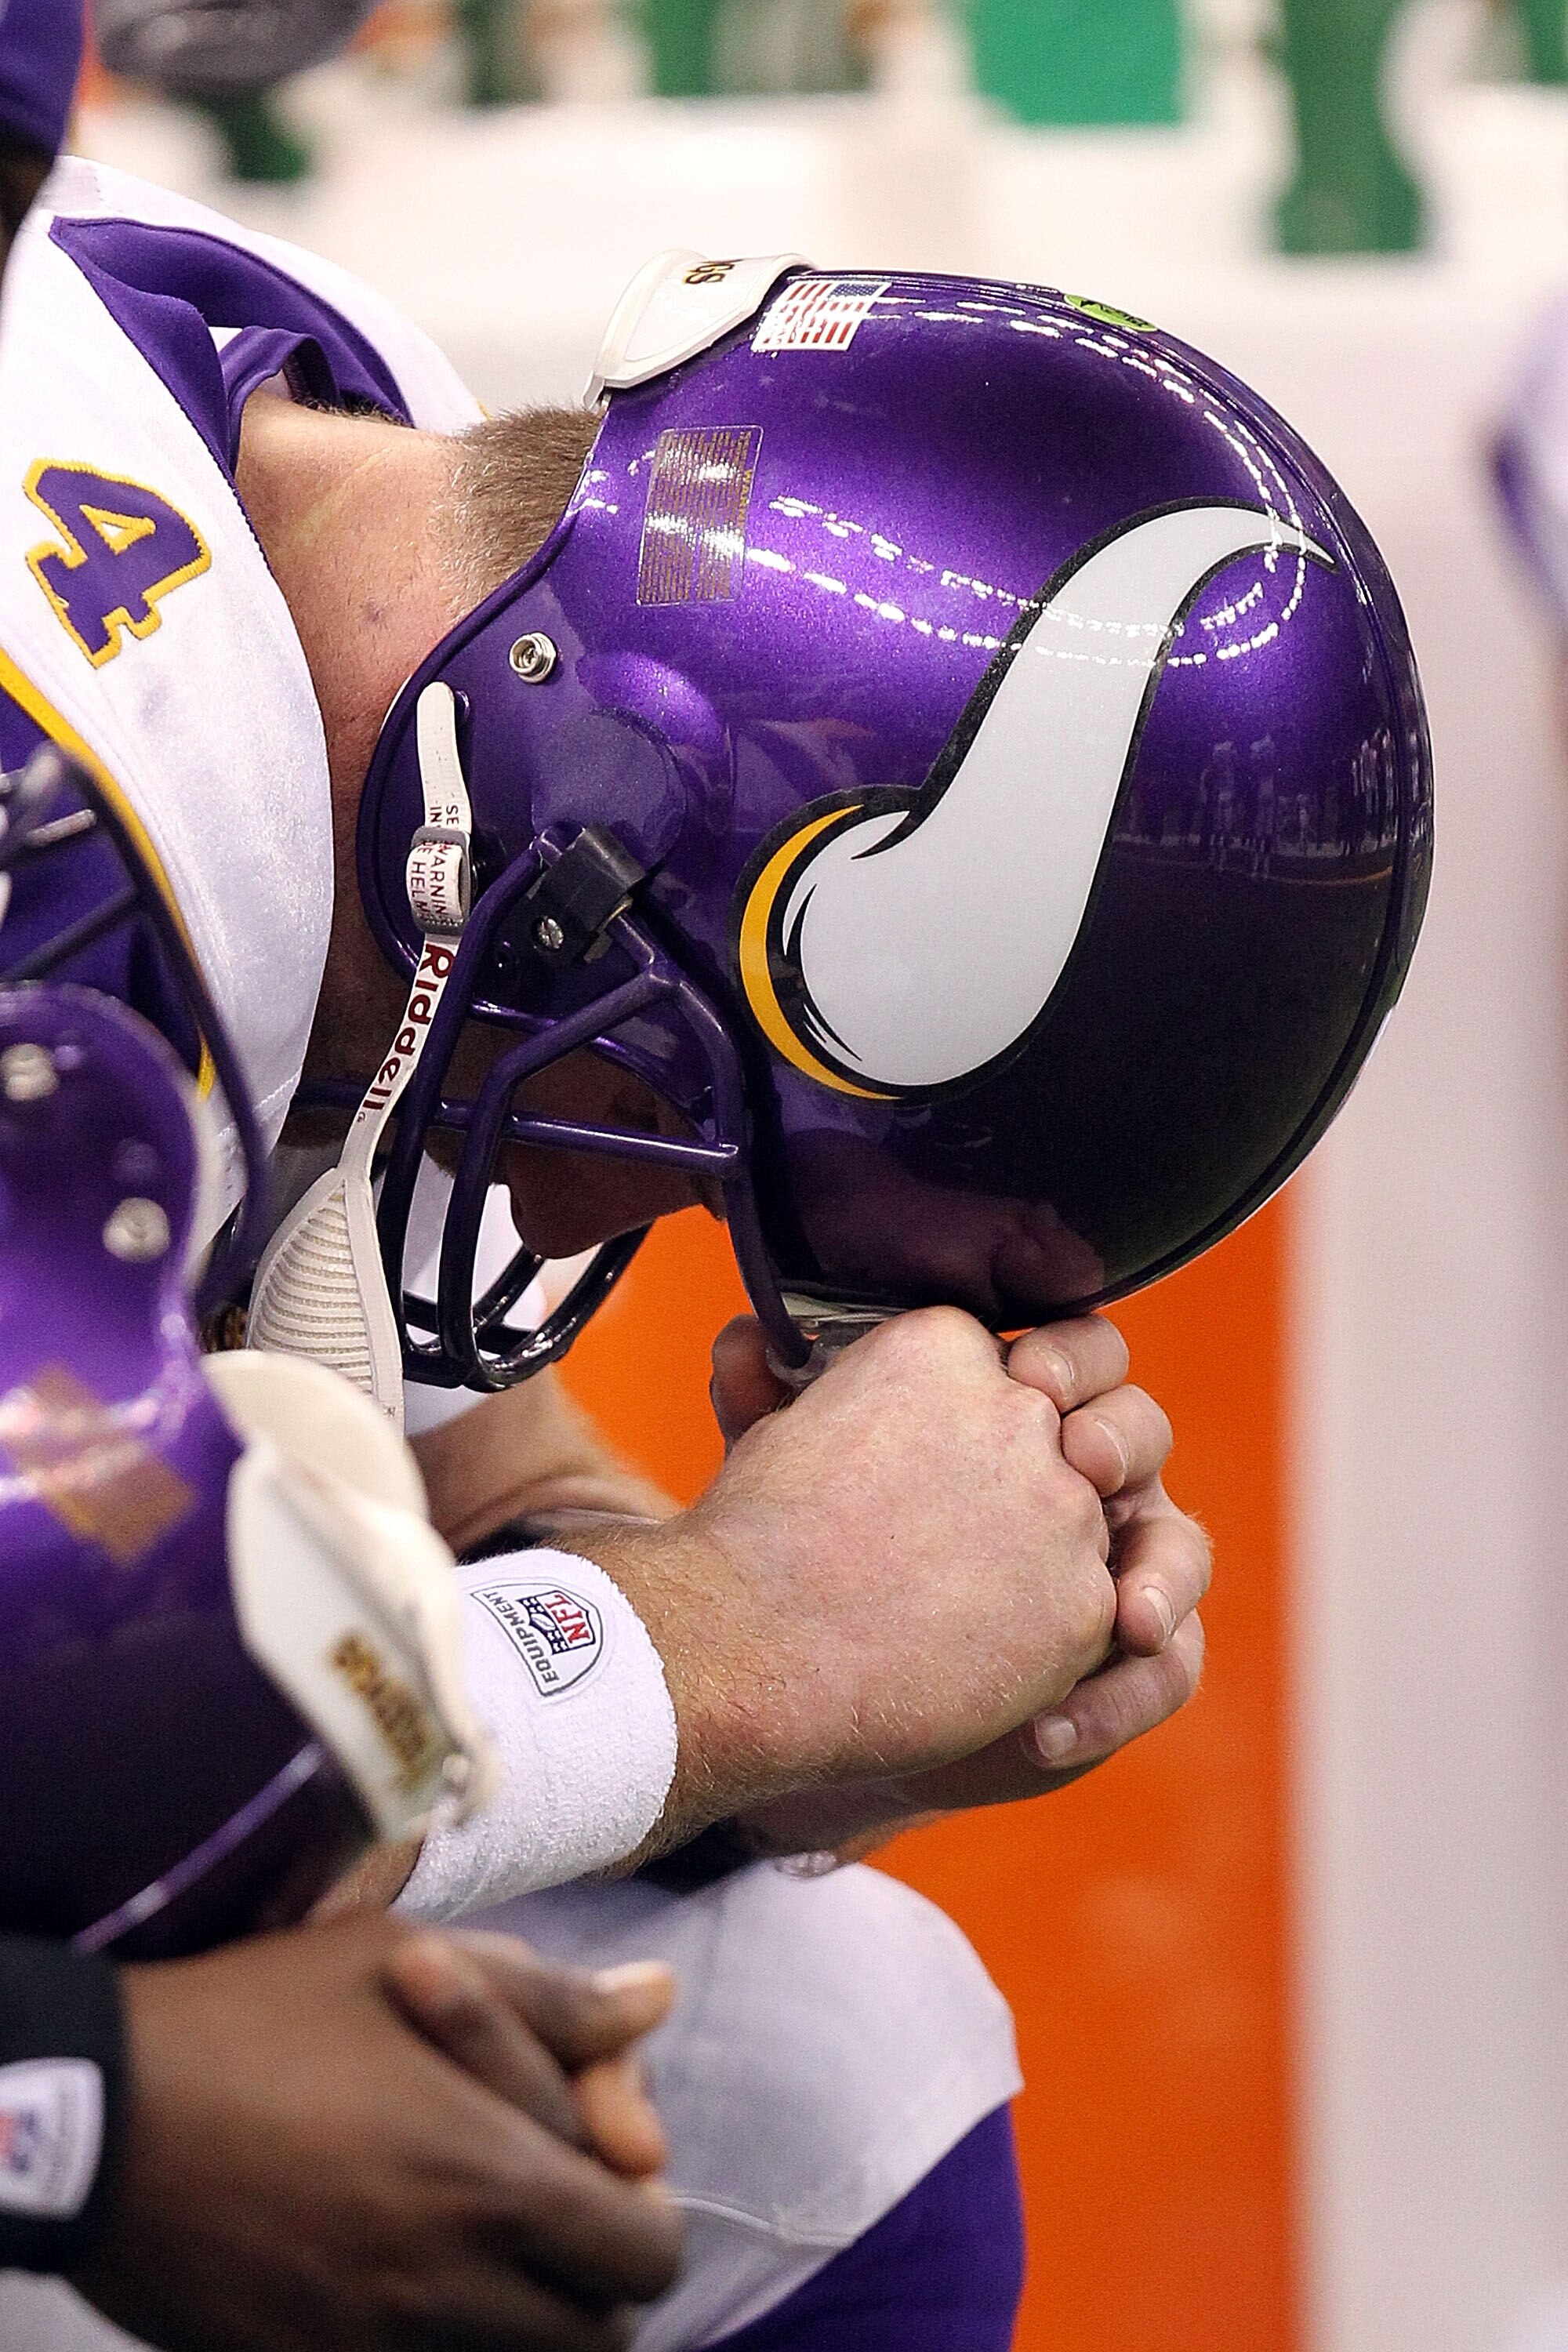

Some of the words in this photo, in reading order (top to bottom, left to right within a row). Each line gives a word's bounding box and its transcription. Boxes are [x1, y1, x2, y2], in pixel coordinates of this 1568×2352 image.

[685, 260, 737, 285] GS
[22, 457, 212, 670] 4
[430, 806, 442, 827] IN
[445, 804, 459, 826] SE
[411, 861, 430, 915] HELM
[430, 842, 452, 916] WARNIN
[362, 943, 456, 1110] Riddell
[483, 1592, 560, 1684] EQUIPMENT
[545, 1595, 591, 1644] NFL
